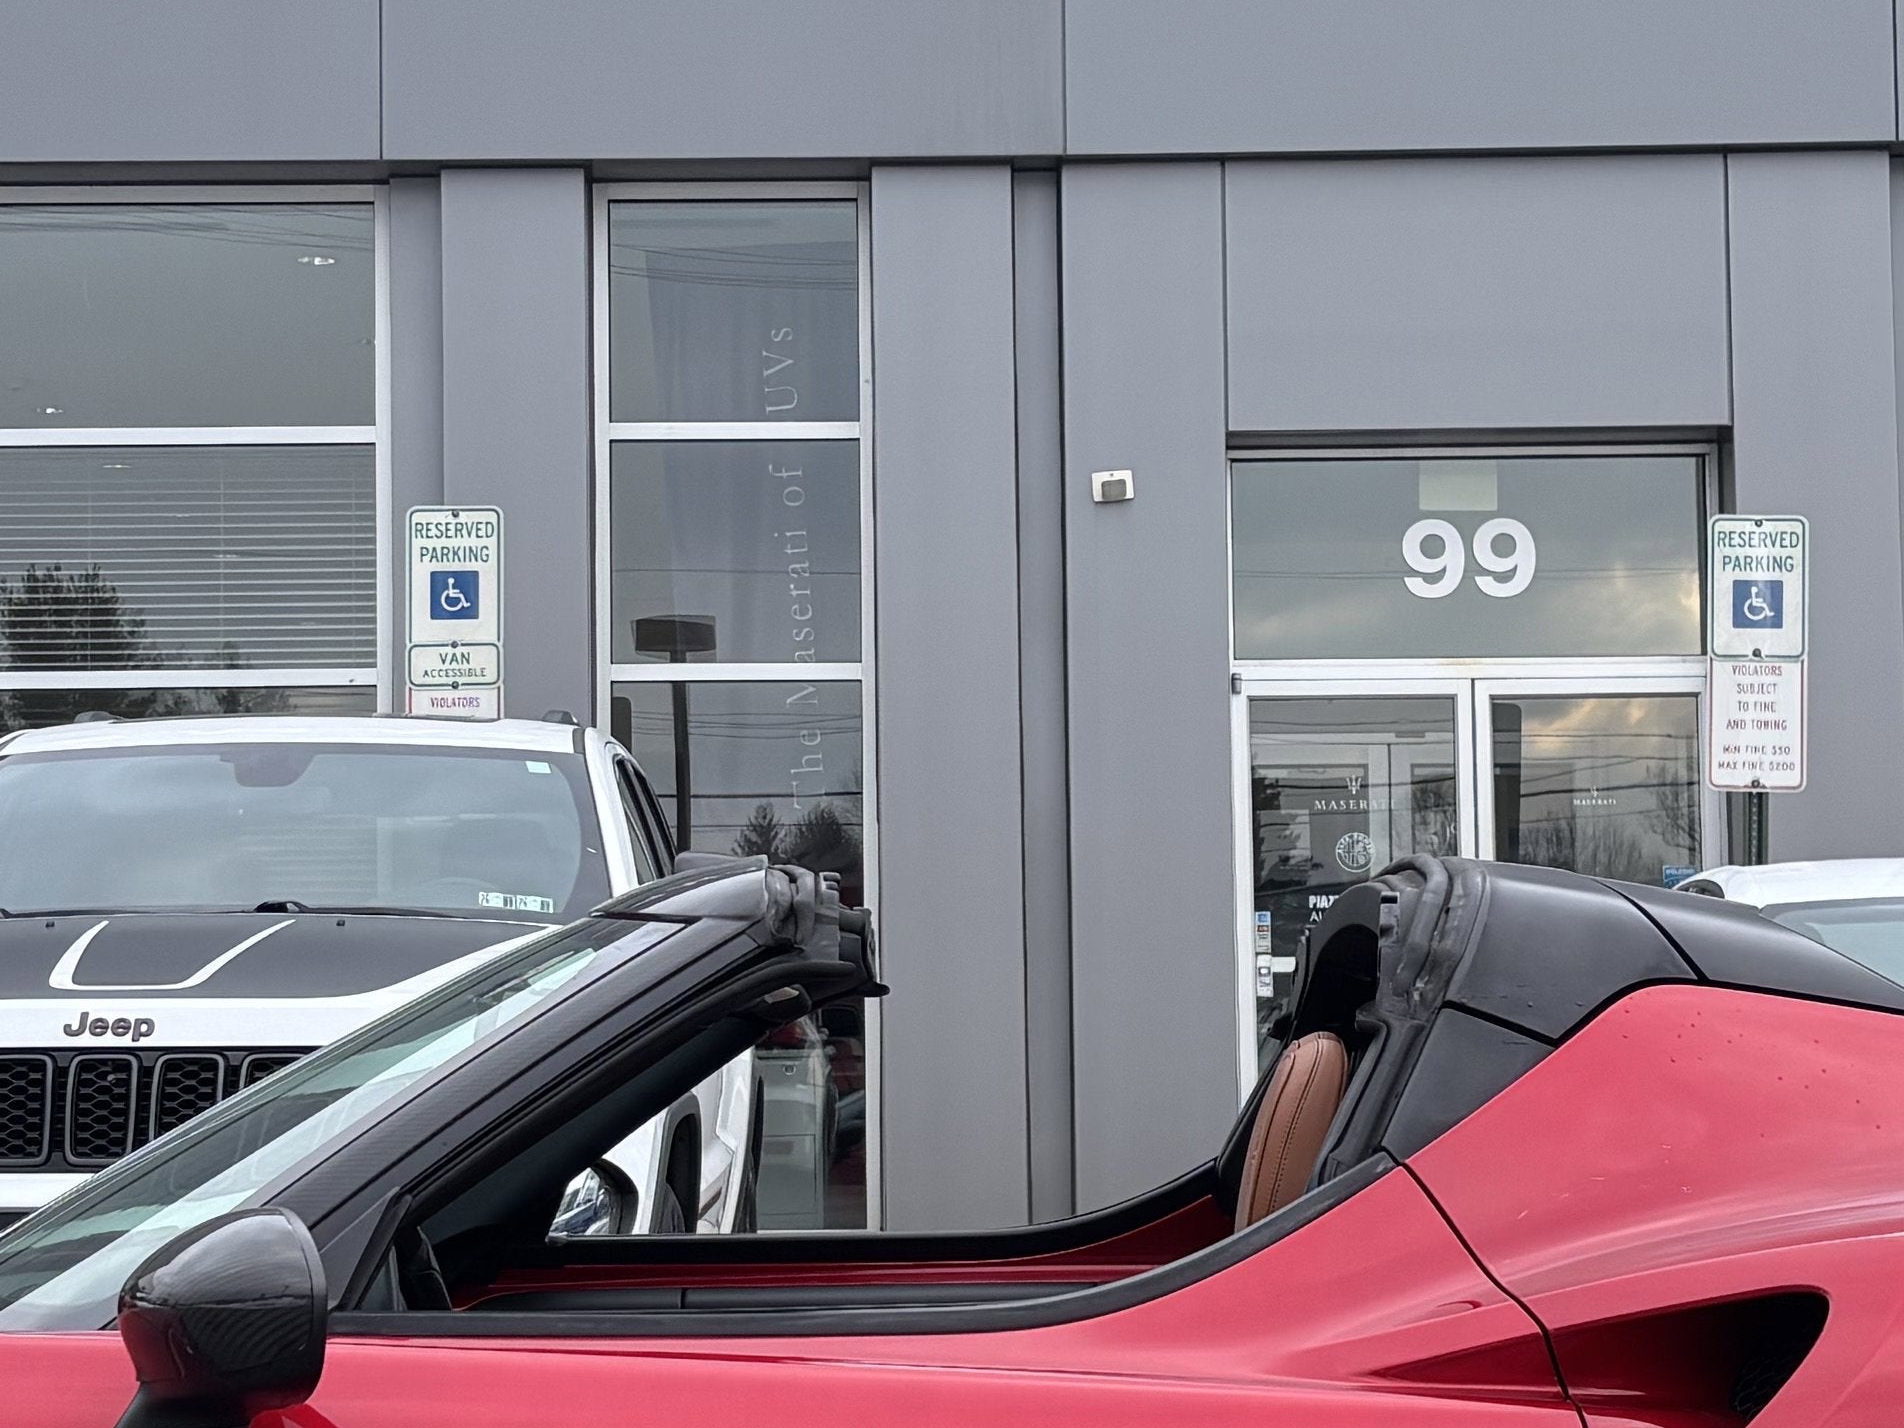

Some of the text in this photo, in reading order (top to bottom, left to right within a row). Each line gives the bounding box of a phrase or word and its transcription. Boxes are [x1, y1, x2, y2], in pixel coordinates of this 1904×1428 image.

[768, 463, 806, 506] of
[414, 521, 495, 539] RESERVED
[1717, 530, 1800, 549] RESERVED
[419, 545, 490, 564] PARKING
[1401, 517, 1537, 599] 99
[1722, 554, 1794, 573] PARKING
[439, 652, 471, 665] VAN
[422, 667, 487, 678] ACCESSIBLE
[1731, 665, 1783, 677] VIOLATORS
[1736, 683, 1778, 694] SUBJECT
[430, 697, 481, 709] VIOLATORS
[1738, 701, 1749, 712] TO
[1726, 719, 1746, 730] AND
[62, 1011, 156, 1043] Jeep
